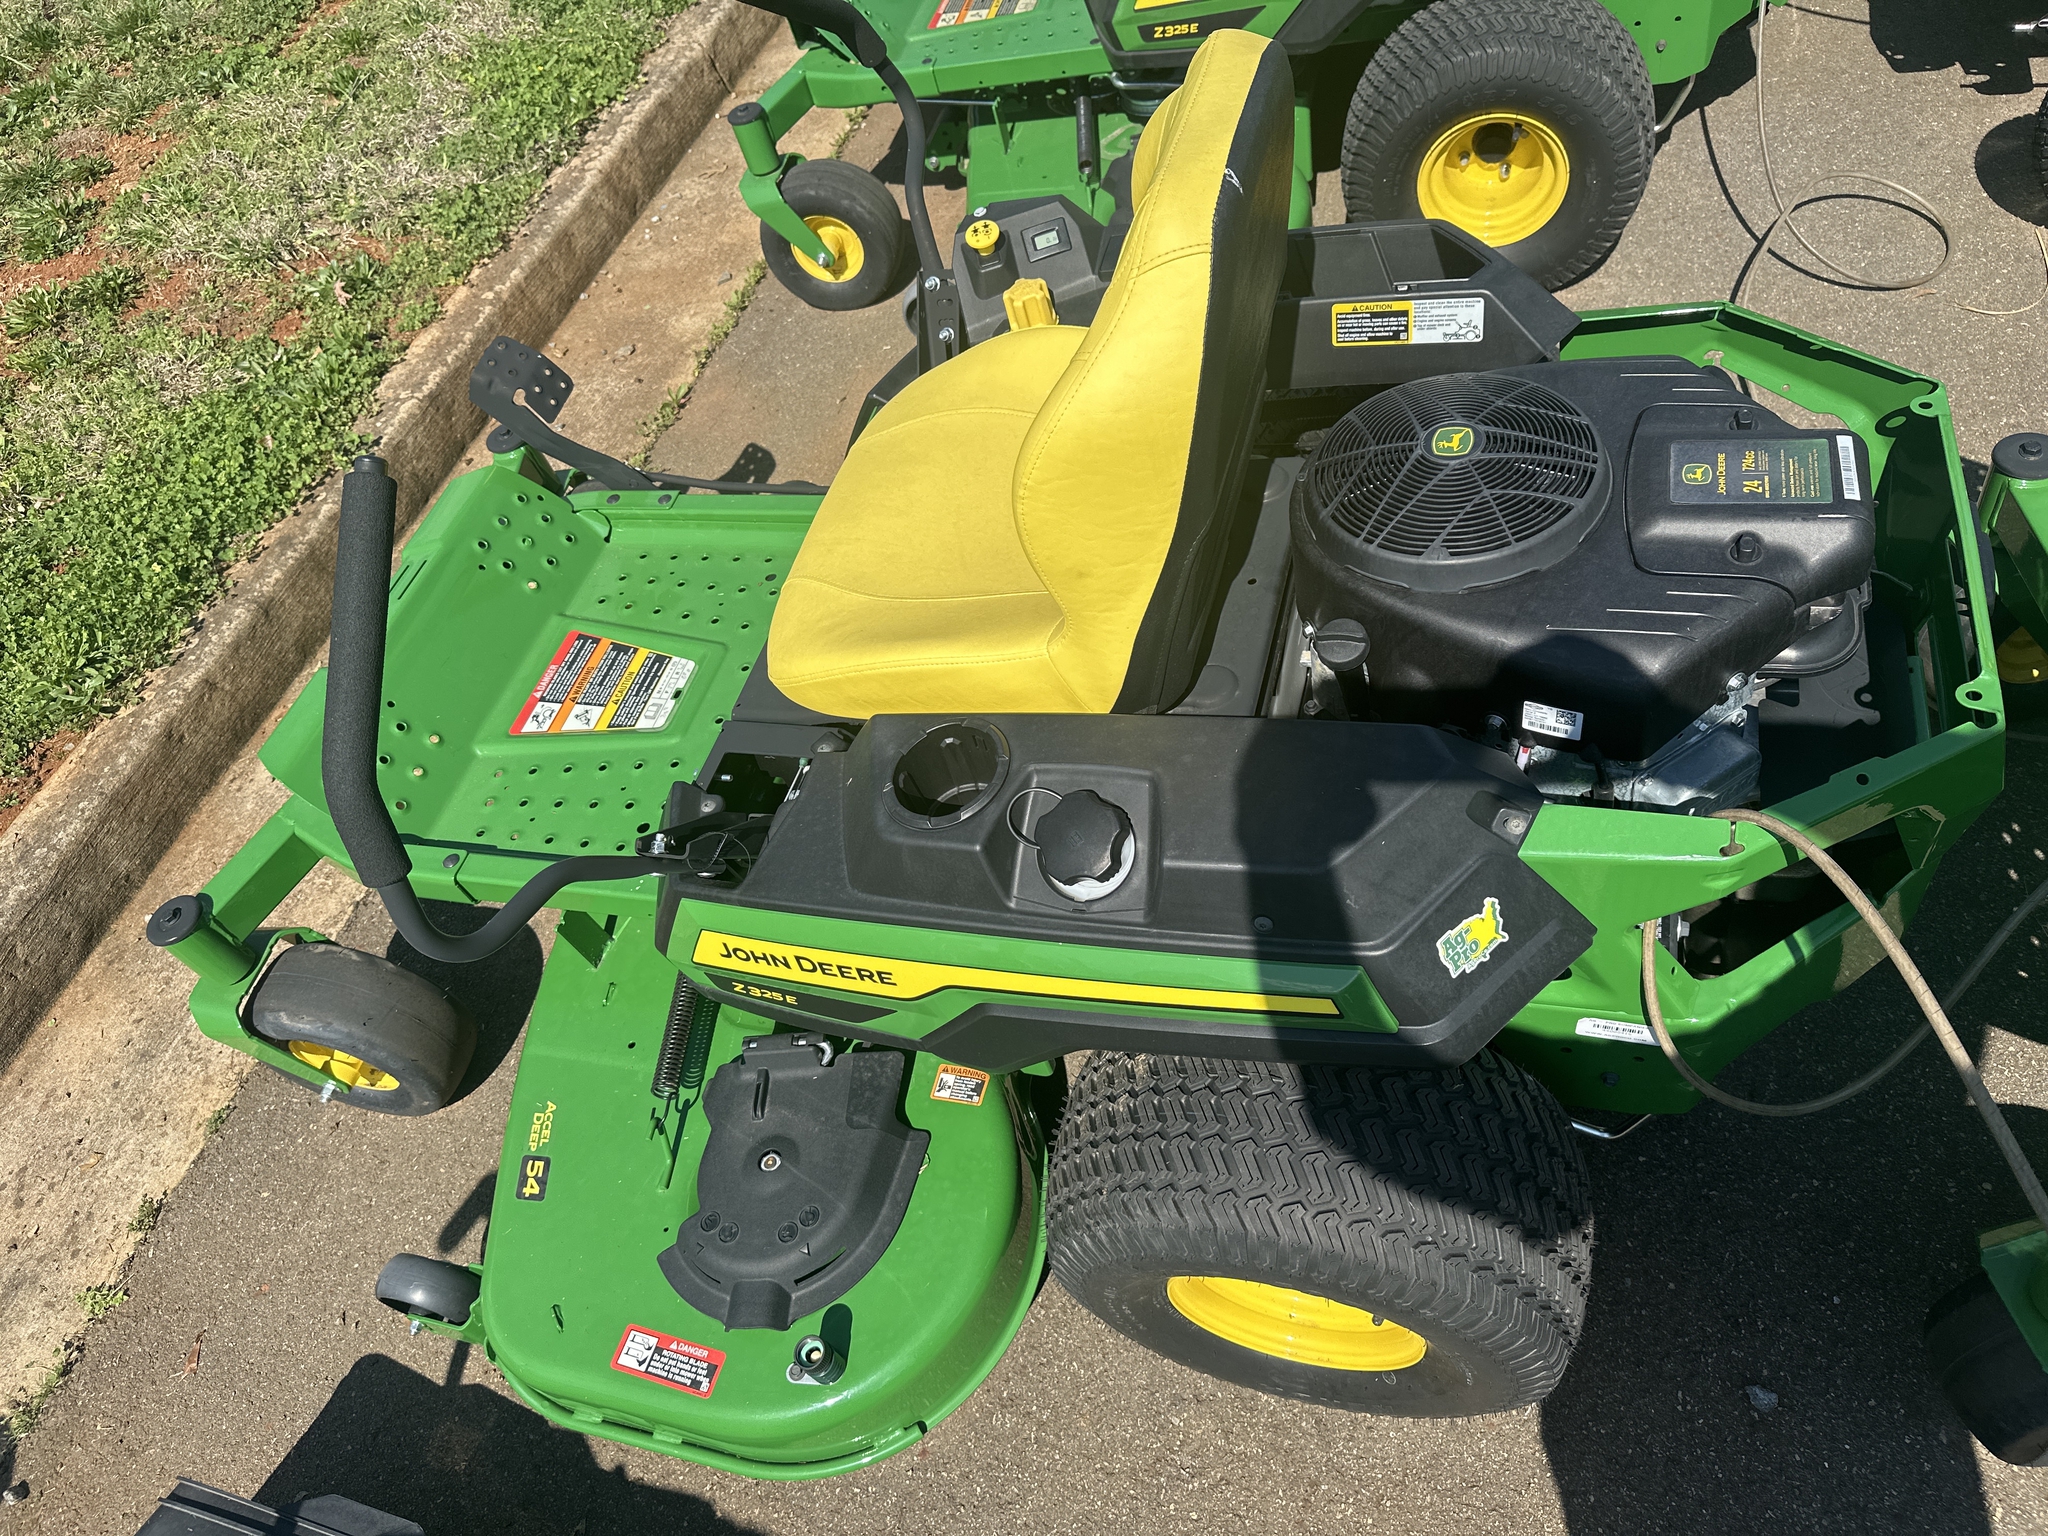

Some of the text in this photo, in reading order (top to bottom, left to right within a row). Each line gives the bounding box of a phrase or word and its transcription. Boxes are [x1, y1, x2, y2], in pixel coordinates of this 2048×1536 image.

[1717, 453, 1726, 496] JOHN DEERE
[1743, 480, 1762, 493] 24
[537, 664, 559, 691] DANGER
[573, 666, 594, 697] WARNING
[616, 672, 635, 697] CAUTION
[719, 942, 897, 986] JOHN DEERE
[1449, 940, 1479, 972] Pro
[951, 1067, 986, 1079] WARNING
[529, 1112, 544, 1151] DEEP
[540, 1101, 556, 1147] ACCEL
[523, 1160, 544, 1197] 54
[662, 1350, 708, 1368] ROTATING BLADE
[678, 1343, 709, 1358] DANGER
